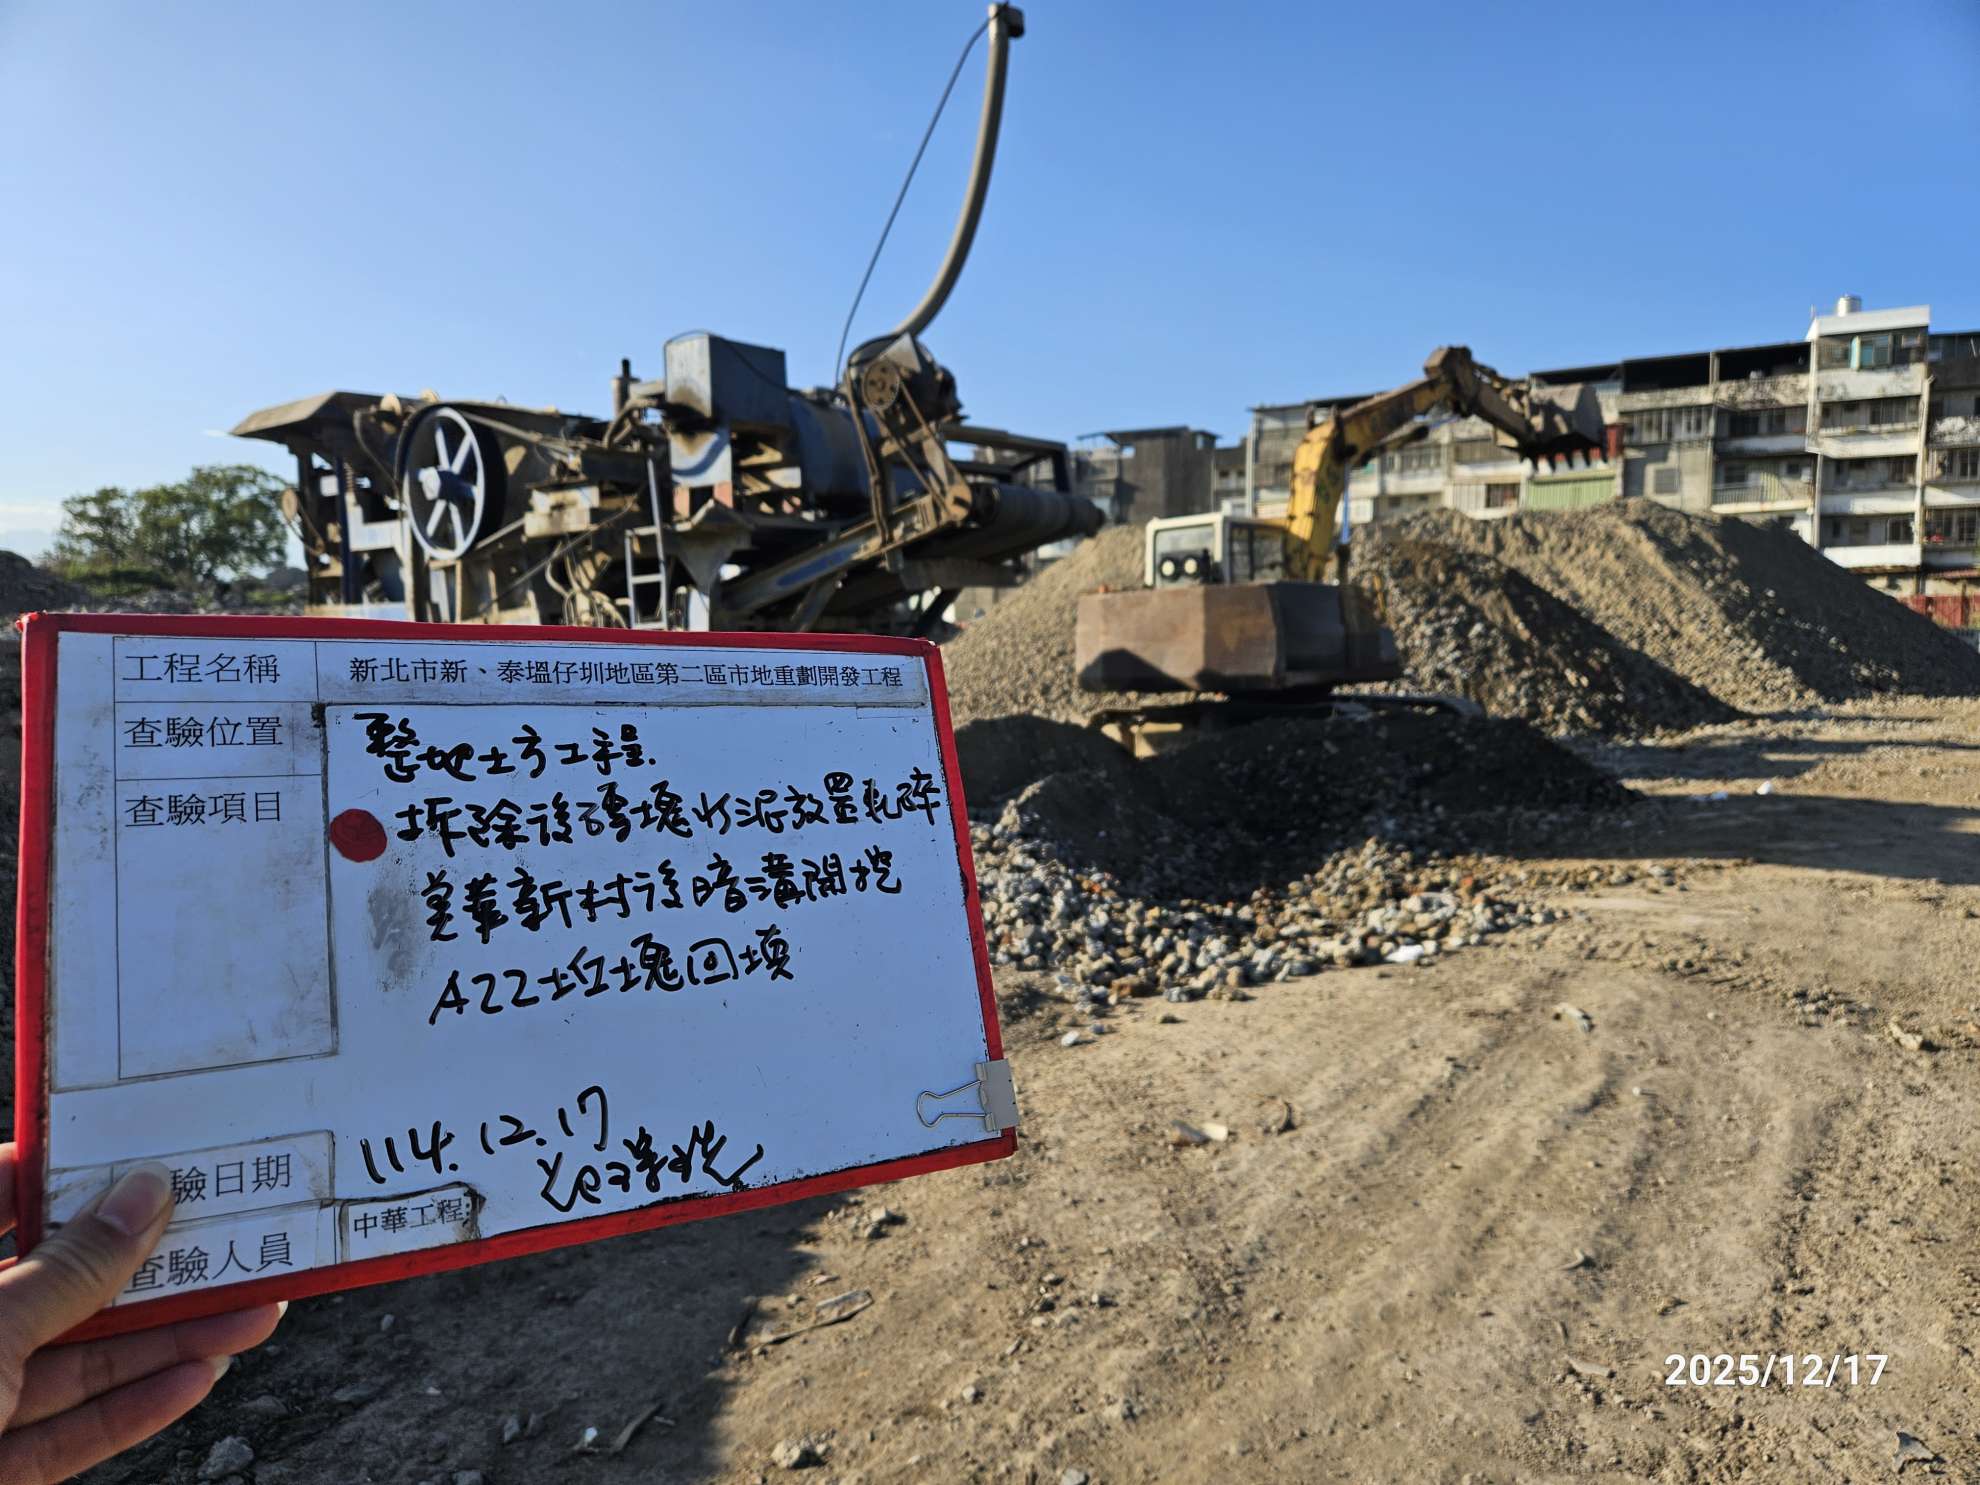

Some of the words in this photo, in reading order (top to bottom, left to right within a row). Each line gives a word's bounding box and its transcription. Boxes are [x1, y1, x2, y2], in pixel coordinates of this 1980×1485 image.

[122, 653, 281, 685] 工程名稱
[123, 716, 283, 749] 查驗位置
[124, 791, 282, 829] 查驗項目
[169, 1152, 292, 1206] 驗日期
[123, 1232, 293, 1294] 查驗人員
